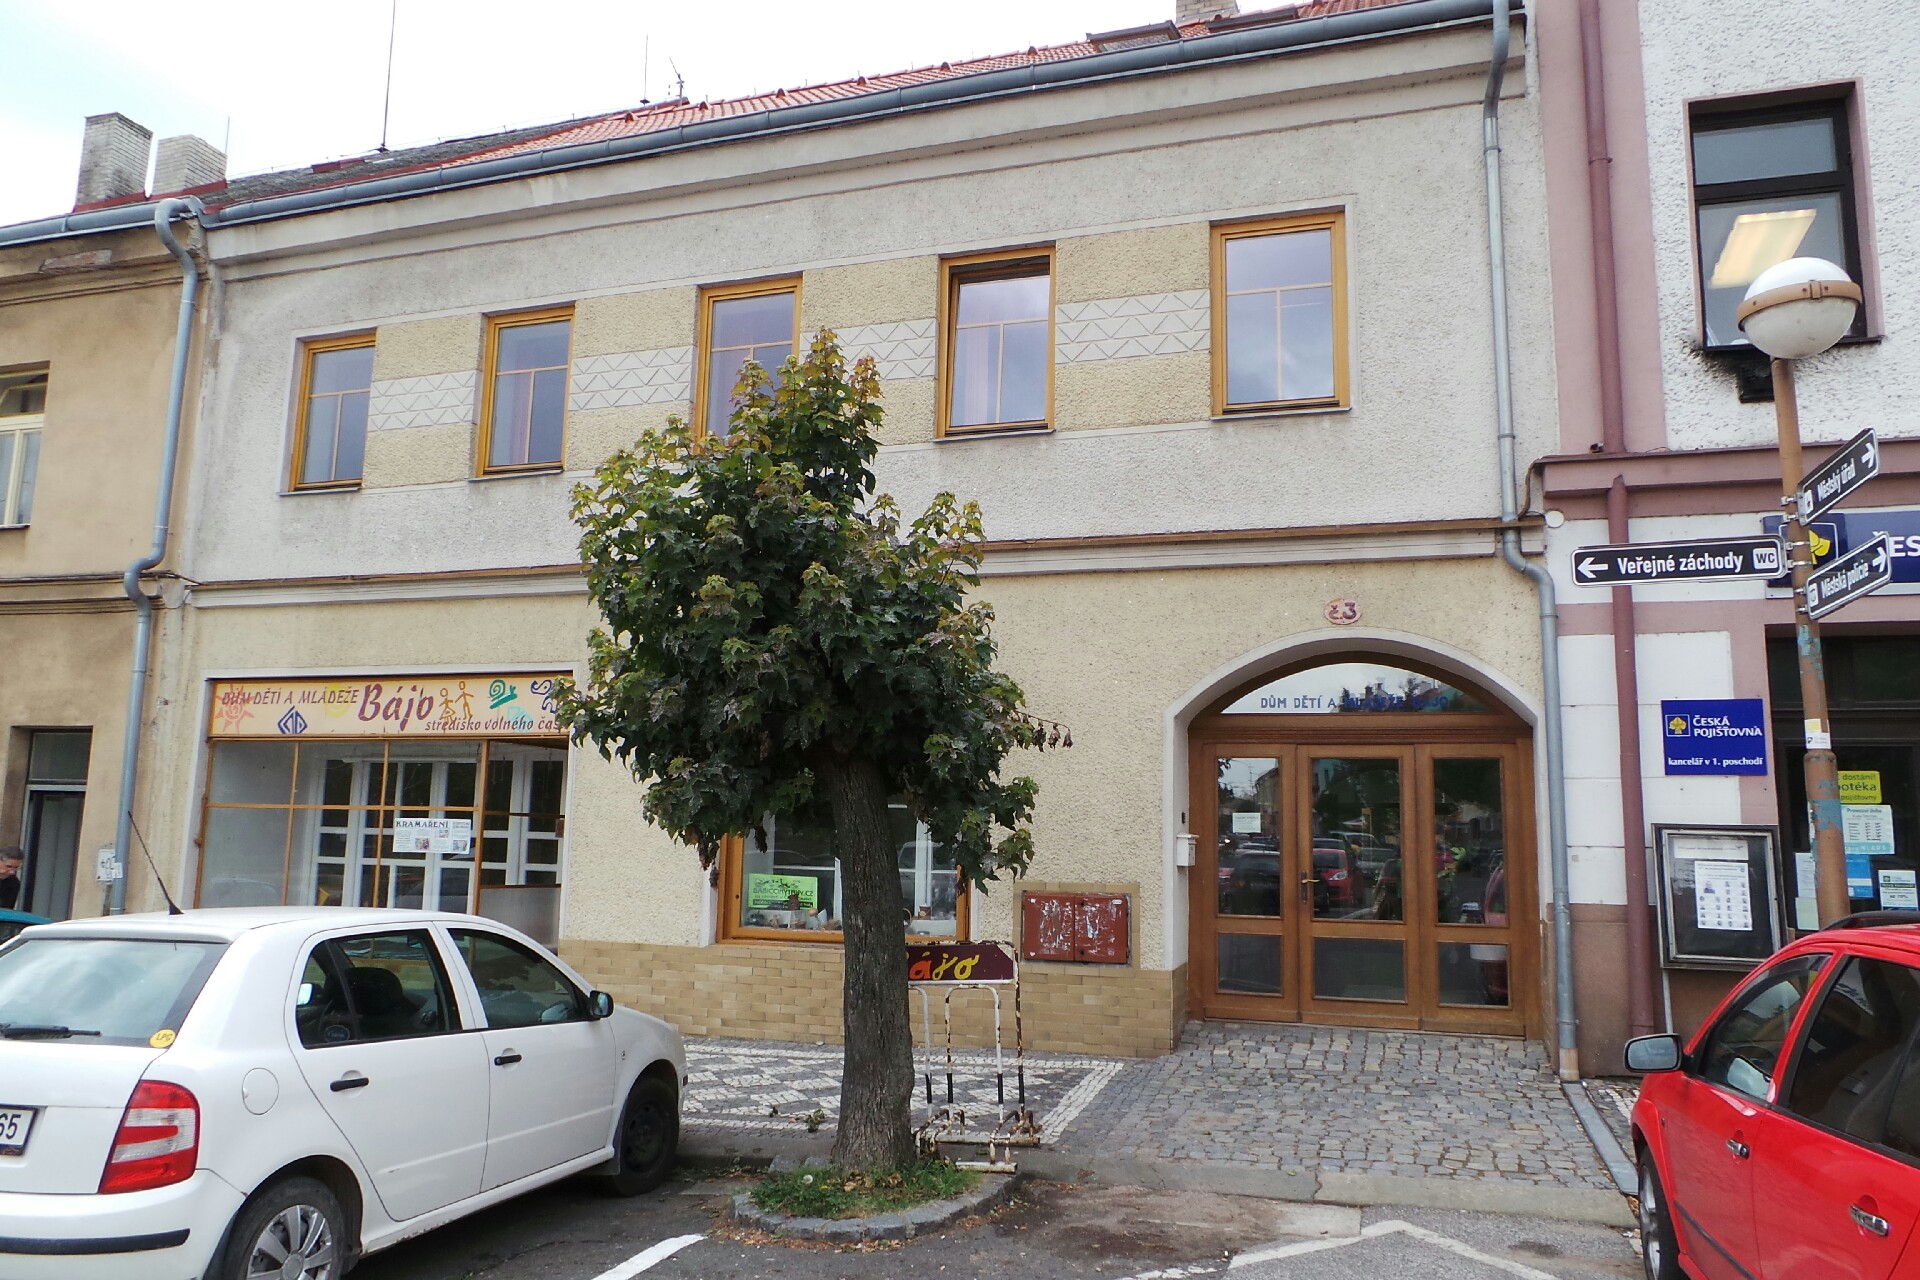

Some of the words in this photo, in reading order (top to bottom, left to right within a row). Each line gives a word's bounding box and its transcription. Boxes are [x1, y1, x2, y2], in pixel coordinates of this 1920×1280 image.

[1817, 468, 1841, 502] Městský
[1841, 457, 1856, 485] úřad
[1617, 554, 1676, 577] Veřejné
[1679, 551, 1744, 573] záchody
[1755, 552, 1776, 564] WC
[1821, 568, 1848, 599] Městská
[1847, 559, 1869, 591] policie
[253, 688, 282, 705] DĚTÍ
[283, 690, 294, 705] A
[298, 686, 360, 704] MLÁDEŽE
[1260, 694, 1287, 709] DŮM
[1293, 694, 1324, 709] DĚTÍ
[1327, 697, 1338, 709] A
[358, 683, 434, 732] Bájo
[484, 715, 534, 730] volného
[537, 716, 560, 730] čas
[1692, 714, 1731, 727] ČESKÁ
[1693, 726, 1763, 739] POJIŠŤOVNA
[1668, 757, 1704, 766] kancelář
[1712, 757, 1721, 766] 1.
[1722, 756, 1764, 768] poschodí
[1839, 781, 1878, 791] otéka
[396, 820, 449, 829] KRAMAŘENÍ
[906, 951, 980, 981] ájo
[155, 1032, 173, 1042] LPG
